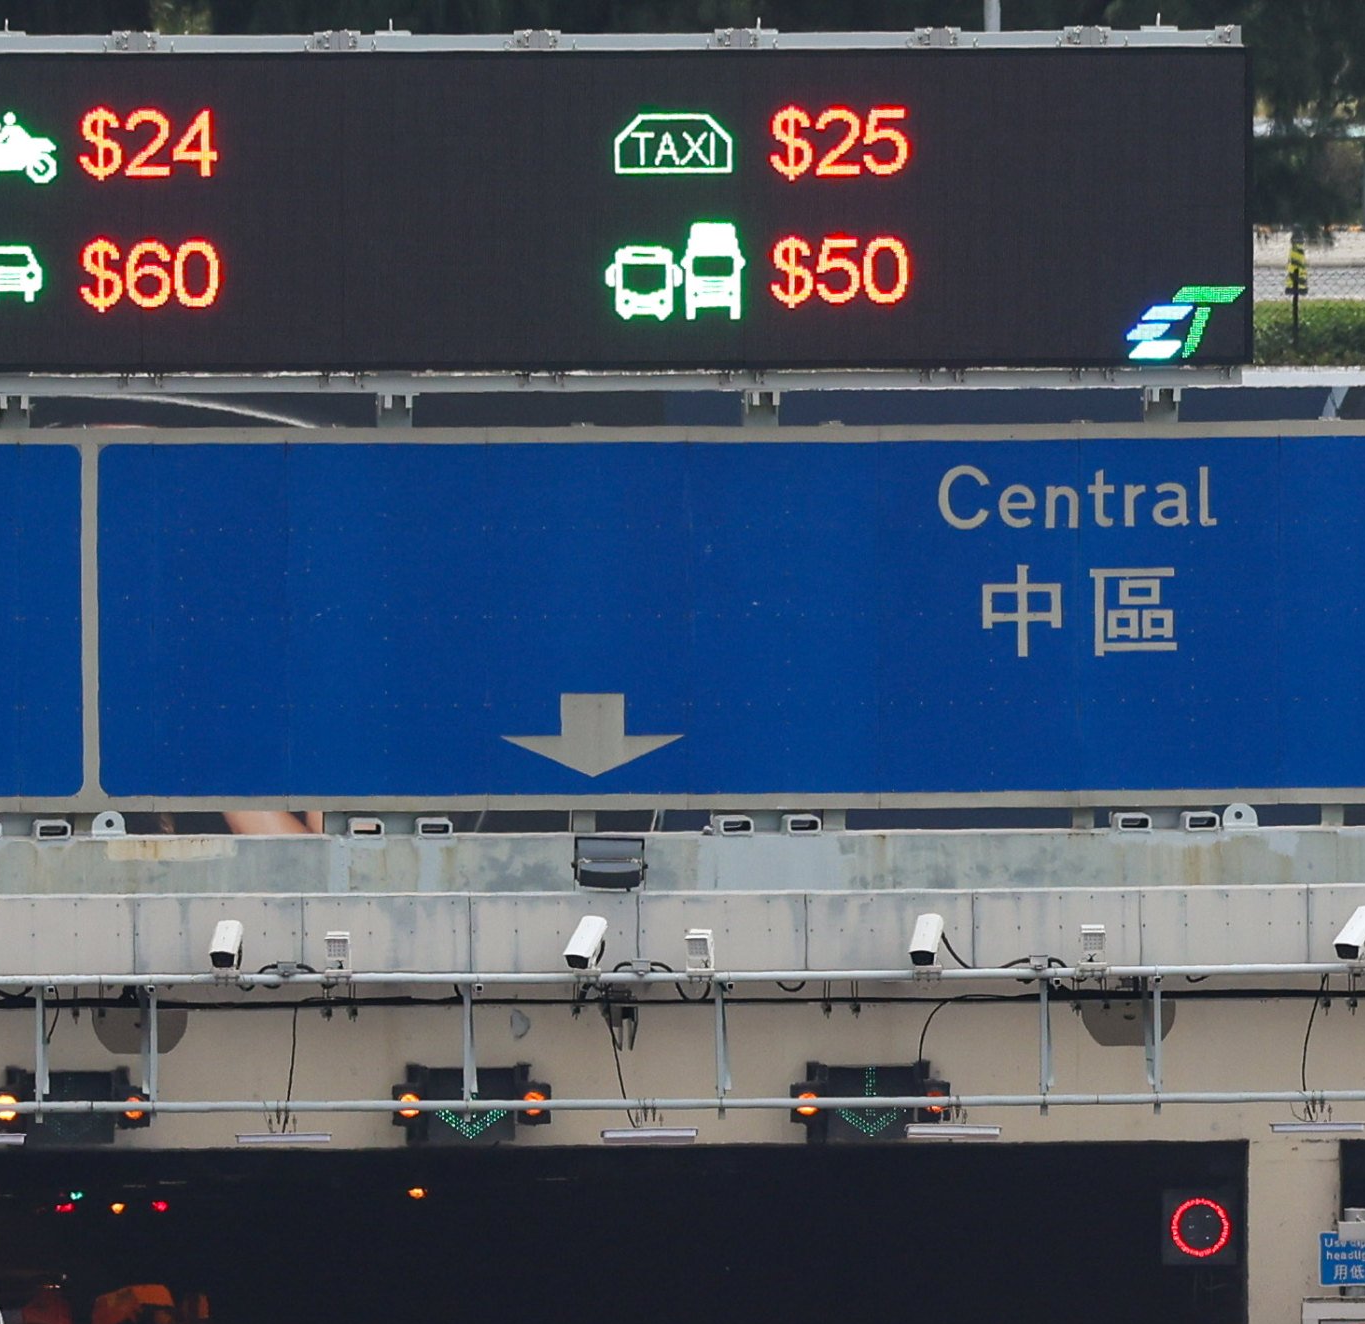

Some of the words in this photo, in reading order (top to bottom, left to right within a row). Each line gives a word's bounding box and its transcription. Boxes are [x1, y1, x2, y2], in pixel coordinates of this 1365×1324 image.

[78, 107, 218, 182] $24
[629, 130, 720, 167] TAXI
[769, 106, 910, 181] $25
[79, 237, 219, 312] $60
[769, 236, 909, 310] $50
[937, 464, 1218, 530] Central
[981, 563, 1178, 657] 中區
